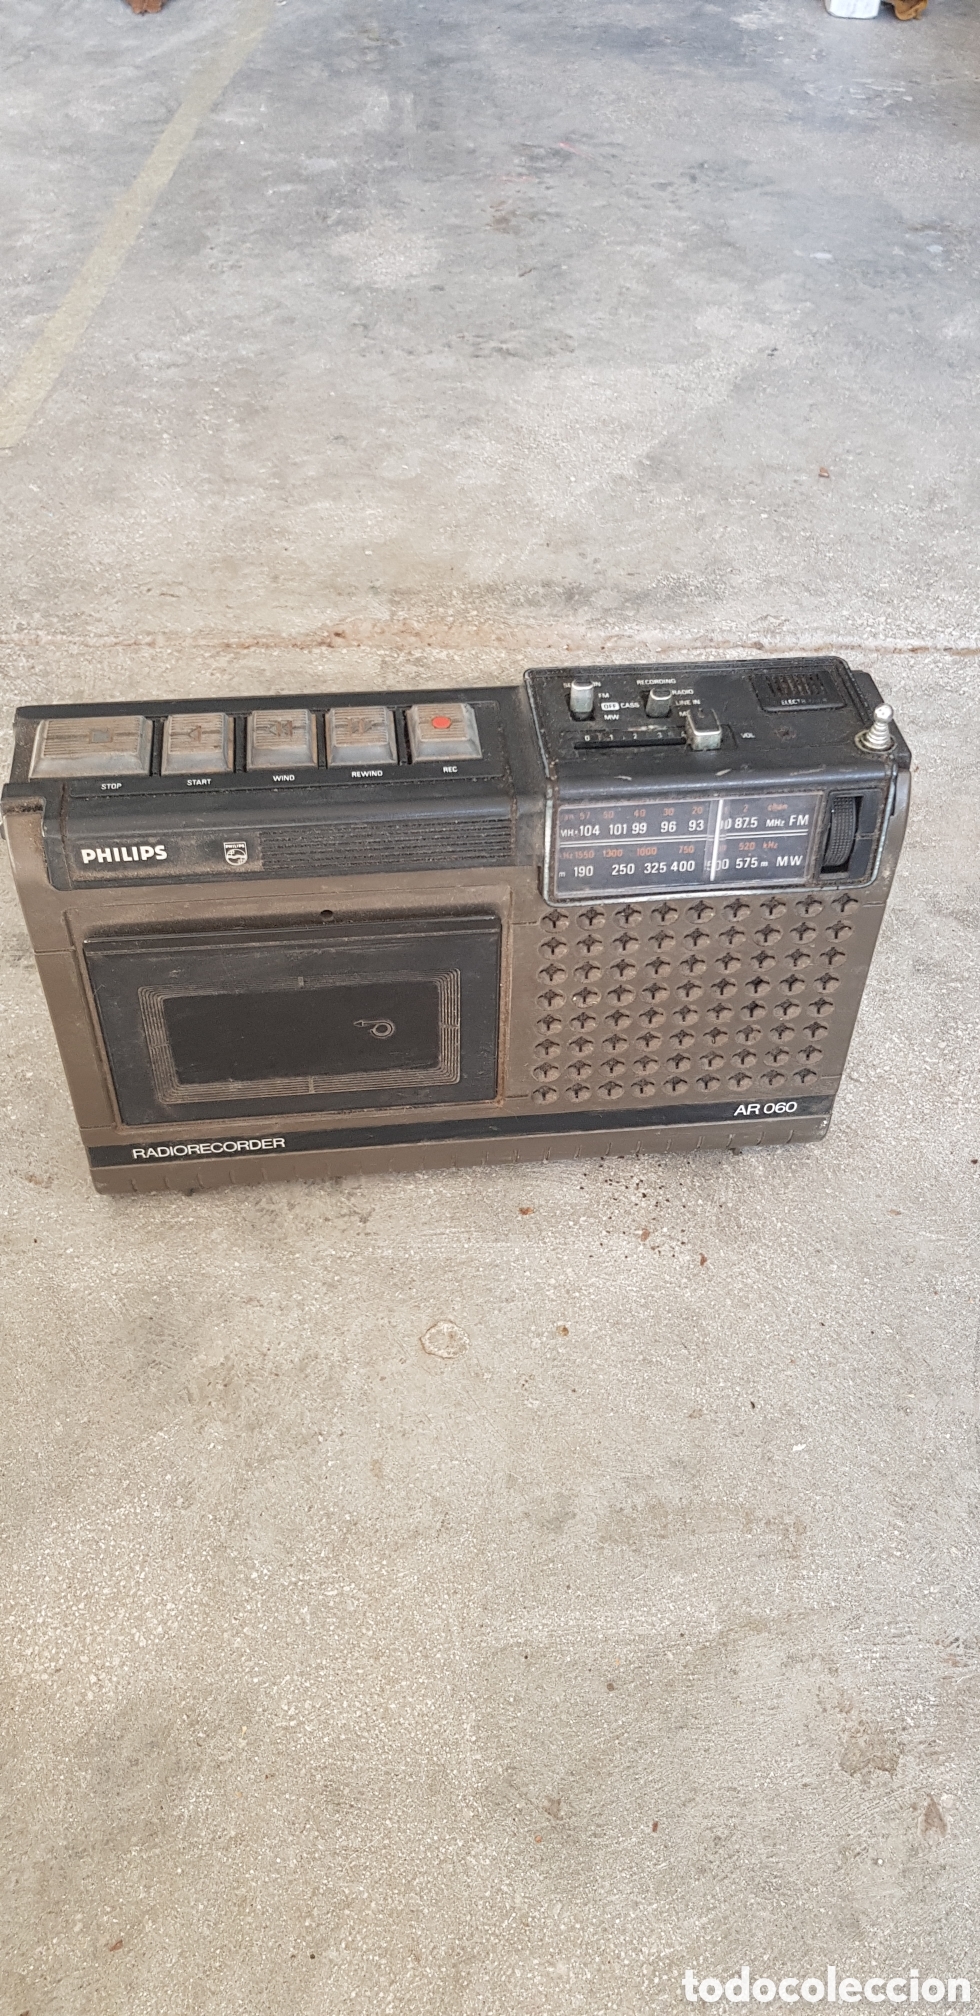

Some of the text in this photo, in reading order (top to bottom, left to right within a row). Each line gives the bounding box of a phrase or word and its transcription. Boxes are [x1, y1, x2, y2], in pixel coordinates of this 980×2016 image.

[636, 678, 677, 686] RECORDING
[657, 731, 663, 739] 3
[351, 770, 383, 778] REWIND
[100, 782, 123, 790] STOP
[186, 778, 212, 786] START
[633, 808, 646, 817] 40
[691, 806, 703, 815] 20
[743, 804, 749, 812] 2
[579, 824, 600, 837] 104
[609, 823, 627, 835] 101
[631, 821, 647, 834] 99
[660, 820, 677, 833] 96
[688, 819, 704, 831] 93
[734, 816, 758, 829] 87.5
[765, 819, 785, 827] MHz
[788, 814, 809, 826] FM
[80, 844, 168, 864] PHILIPS
[636, 846, 658, 856] 1000
[678, 845, 695, 854] 750
[738, 842, 756, 851] 520
[762, 841, 778, 849] kHz
[574, 865, 594, 877] 190
[611, 863, 635, 875] 250
[643, 861, 667, 874] 325
[670, 860, 695, 872] 400
[735, 857, 758, 869] 575
[775, 855, 803, 867] MW
[733, 1101, 798, 1116] AR 060
[132, 1137, 286, 1159] RADIORECORDER
